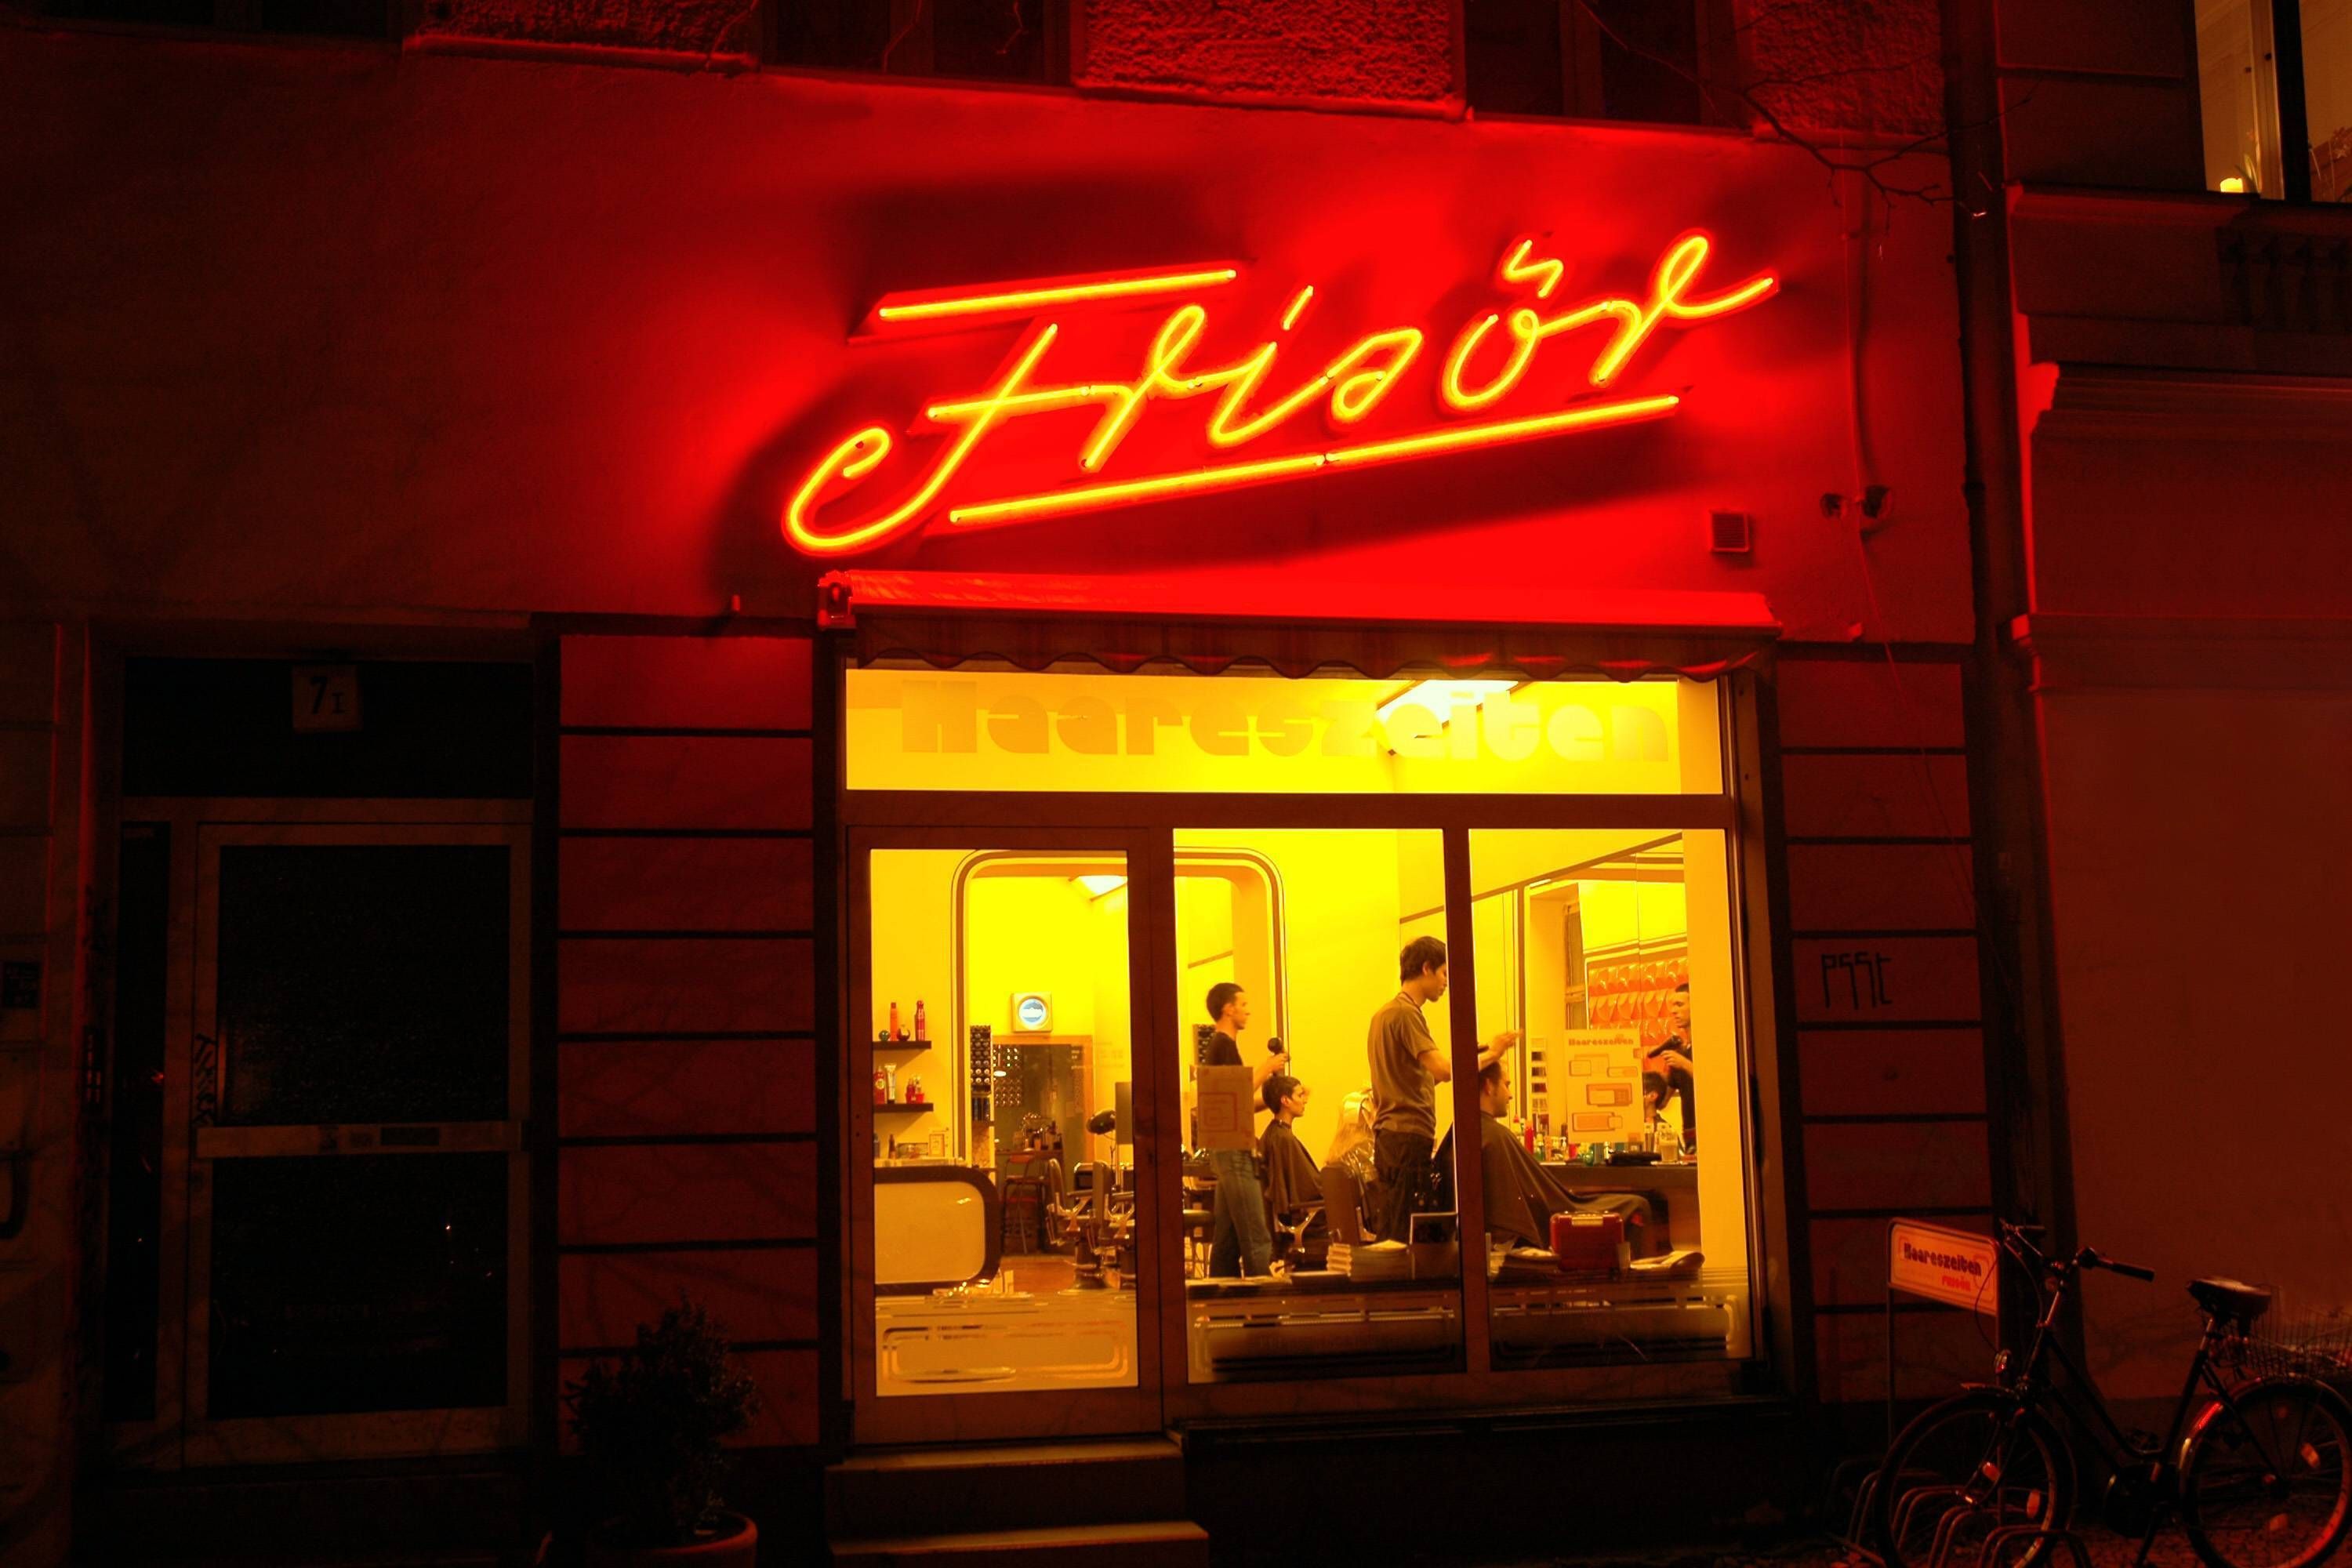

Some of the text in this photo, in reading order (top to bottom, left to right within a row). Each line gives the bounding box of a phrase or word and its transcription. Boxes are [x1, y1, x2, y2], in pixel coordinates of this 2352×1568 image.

[785, 230, 1779, 556] Frisör
[902, 681, 1670, 762] Haareszeiten
[1904, 1243, 1982, 1277] Haareszeiten
